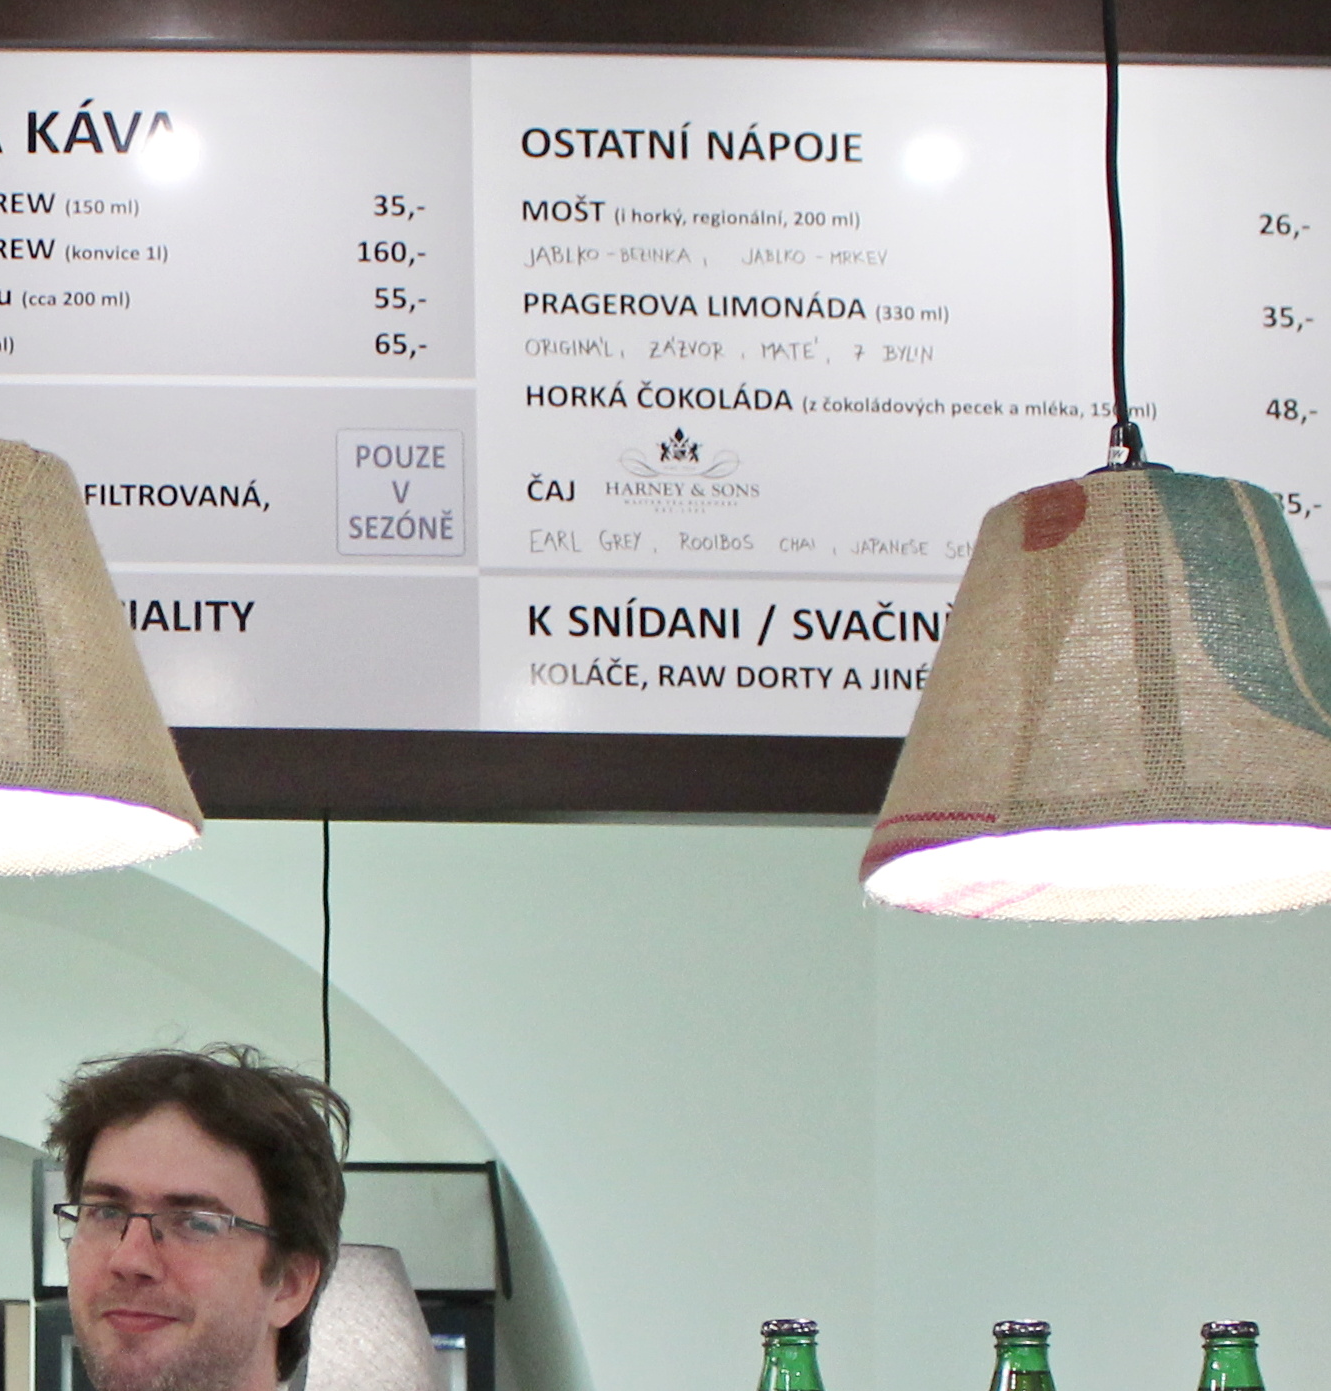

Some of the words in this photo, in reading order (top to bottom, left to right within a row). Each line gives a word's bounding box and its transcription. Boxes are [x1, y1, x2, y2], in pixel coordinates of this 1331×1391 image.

[521, 122, 691, 163] OSTATNÍ
[708, 122, 864, 164] NÁPOJE
[65, 199, 105, 217] (150
[111, 199, 141, 217] ml)
[373, 193, 427, 221] 35,-
[522, 195, 607, 224] MOŠT
[632, 206, 688, 230] horký,
[692, 206, 788, 230] regionální,
[794, 209, 824, 228] 200
[830, 208, 862, 230] ml)
[1258, 214, 1312, 243] 26,-
[65, 244, 140, 263] (konvice
[356, 240, 428, 269] 160,-
[524, 245, 601, 268] JABLKO
[742, 247, 807, 266] JABLKO
[21, 291, 57, 309] (cca
[63, 291, 96, 307] 200
[101, 290, 132, 310] ml)
[373, 285, 428, 314] 55,-
[524, 293, 698, 317] PRAGEROVA
[707, 292, 867, 320] LIMONÁDA
[874, 305, 916, 323] (330
[920, 304, 951, 324] ml)
[1261, 305, 1315, 334] 35,-
[374, 332, 429, 360] 65,-
[526, 379, 629, 409] HORKÁ
[635, 379, 795, 413] ČOKOLÁDA
[802, 396, 818, 414] (z
[823, 395, 946, 417] čokoládových
[950, 399, 1004, 417] pecek
[1009, 403, 1020, 415] a
[1024, 400, 1085, 419] mléka,
[1129, 402, 1158, 421] ml)
[1265, 396, 1319, 425] 48,-
[355, 443, 447, 469] POUZE
[84, 479, 271, 512] FILTROVANÁ,
[392, 479, 411, 504] V
[527, 473, 576, 503] ČAJ
[605, 481, 685, 498] HARNEY
[690, 482, 706, 497] &
[711, 482, 761, 499] SONS
[348, 507, 454, 542] SEZÓNĚ
[529, 529, 582, 554] EARL
[123, 600, 255, 633] IALITY
[529, 606, 552, 638] K
[568, 597, 742, 642] SNÍDANI
[793, 599, 950, 644] SVAČIN
[530, 657, 650, 693] KOLÁČE,
[659, 664, 727, 691] RAW
[737, 664, 835, 692] DORTY
[841, 666, 863, 691] A
